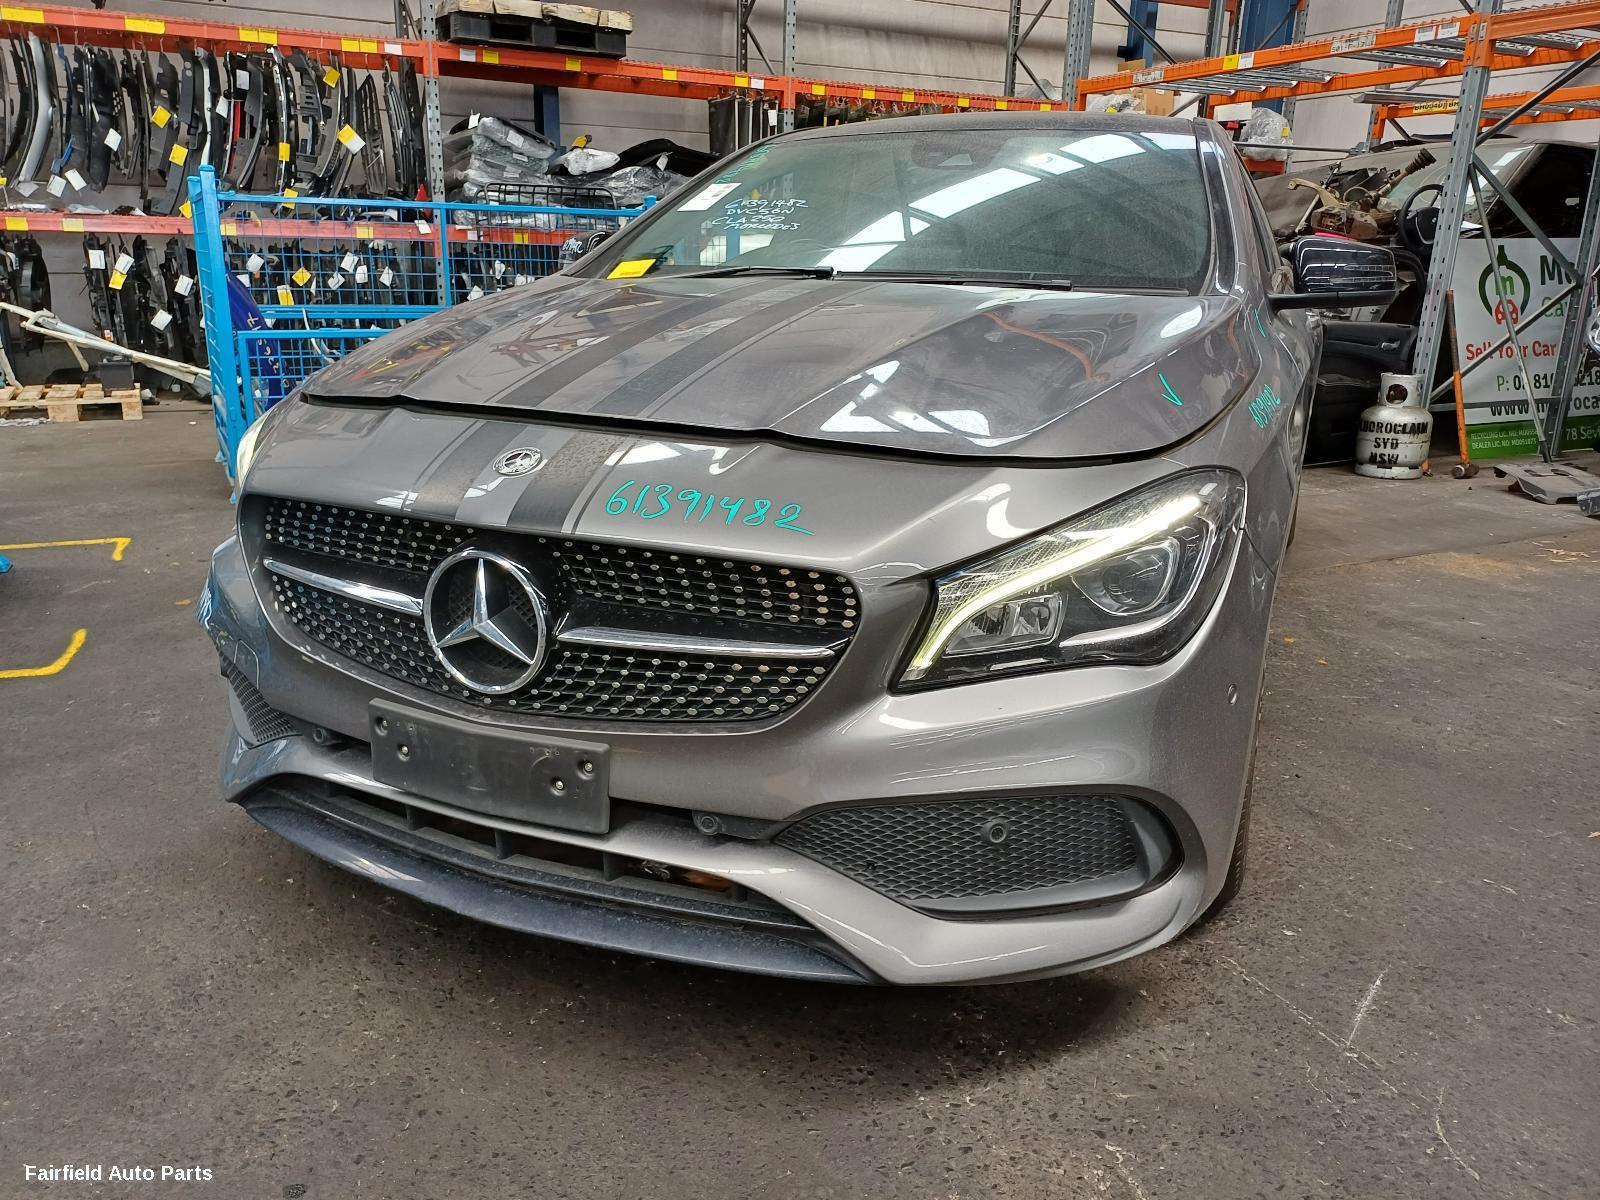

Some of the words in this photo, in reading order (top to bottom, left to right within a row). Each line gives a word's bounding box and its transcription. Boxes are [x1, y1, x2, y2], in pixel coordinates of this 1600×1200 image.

[1532, 340, 1557, 357] Car
[1496, 375, 1509, 391] P:
[1566, 428, 1578, 441] 78
[605, 479, 816, 536] 61391482
